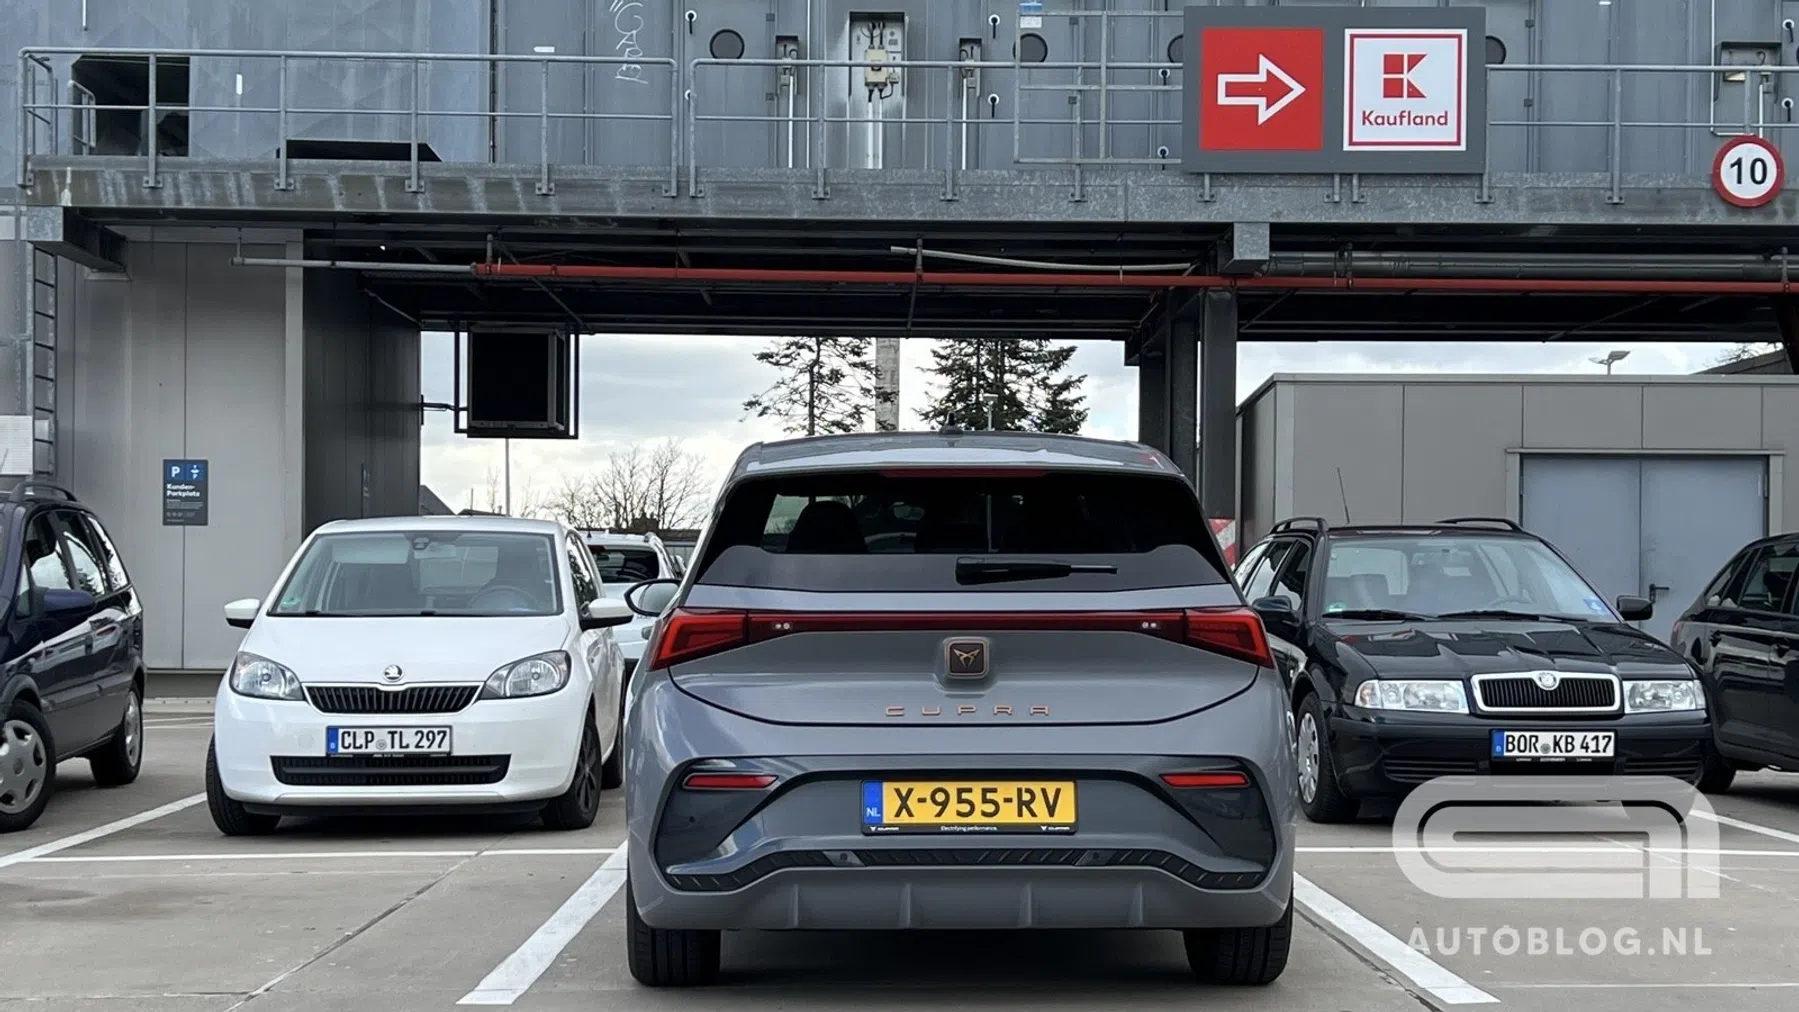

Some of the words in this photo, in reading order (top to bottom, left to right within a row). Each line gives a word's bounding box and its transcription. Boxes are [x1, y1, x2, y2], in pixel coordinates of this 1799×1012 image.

[1362, 110, 1448, 126] Kaufland
[1730, 157, 1768, 185] 10
[171, 466, 180, 478] P
[885, 704, 1050, 717] CUPRA
[341, 730, 375, 750] CLP
[387, 730, 410, 749] TL
[414, 730, 448, 749] 297
[1505, 734, 1539, 754] BOR
[1553, 734, 1576, 753] KB
[1580, 734, 1613, 753] 417
[893, 787, 1062, 818] X-955-RV
[866, 808, 881, 817] NL
